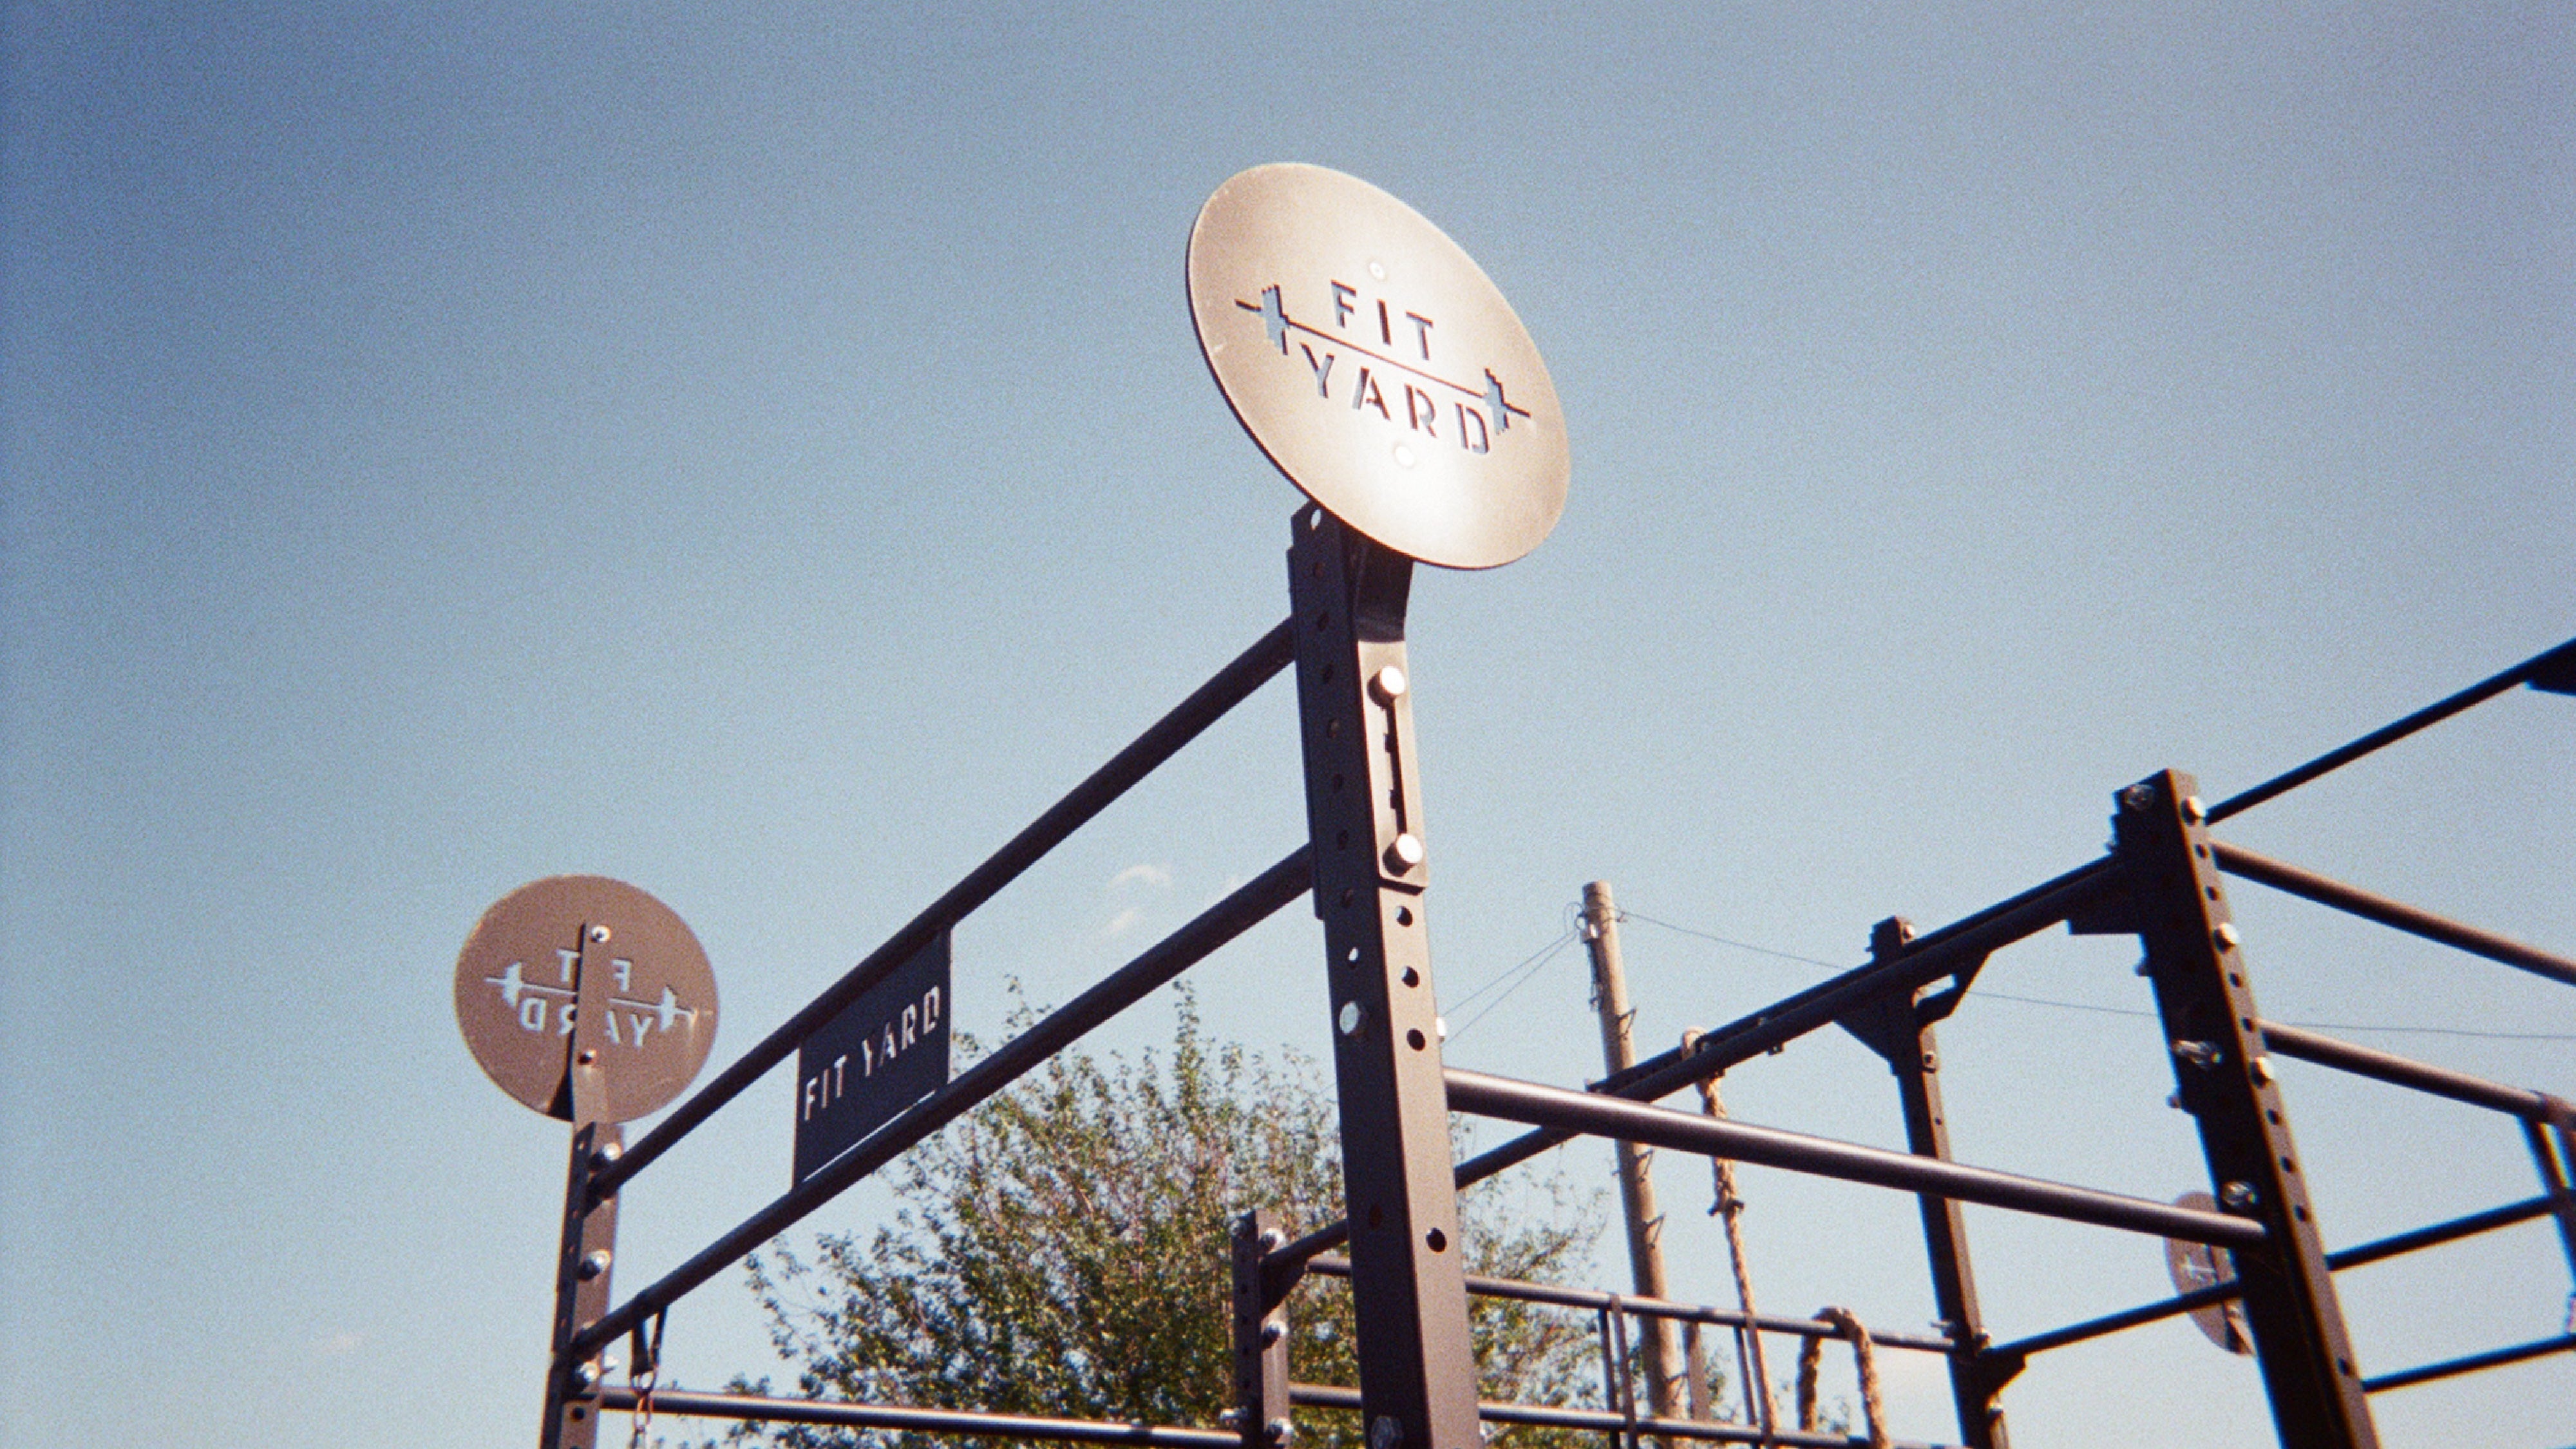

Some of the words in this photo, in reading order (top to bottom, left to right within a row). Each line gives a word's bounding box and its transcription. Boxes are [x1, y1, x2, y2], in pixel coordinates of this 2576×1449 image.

[1331, 279, 1434, 361] FIT
[1299, 342, 1490, 454] YARD
[804, 1054, 848, 1121] FIT
[862, 985, 940, 1077] YARD
